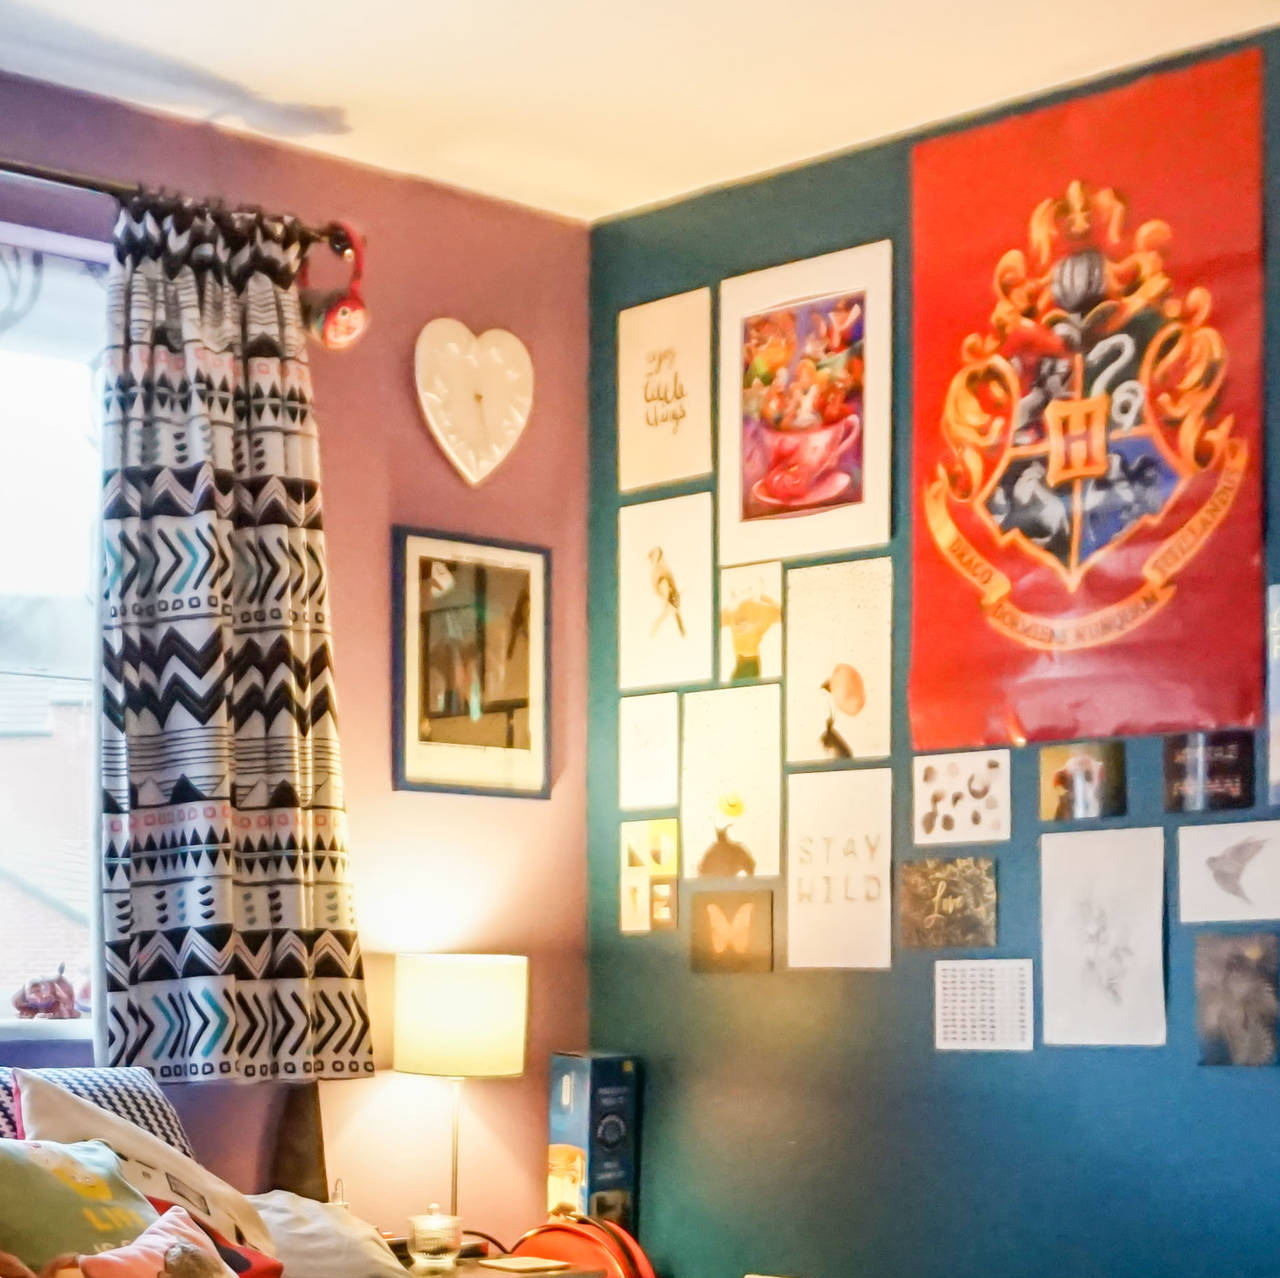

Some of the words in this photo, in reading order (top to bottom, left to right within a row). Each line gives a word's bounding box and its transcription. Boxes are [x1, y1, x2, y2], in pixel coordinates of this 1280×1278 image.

[1060, 411, 1097, 470] H
[798, 833, 882, 865] STAY
[797, 874, 882, 905] WILD
